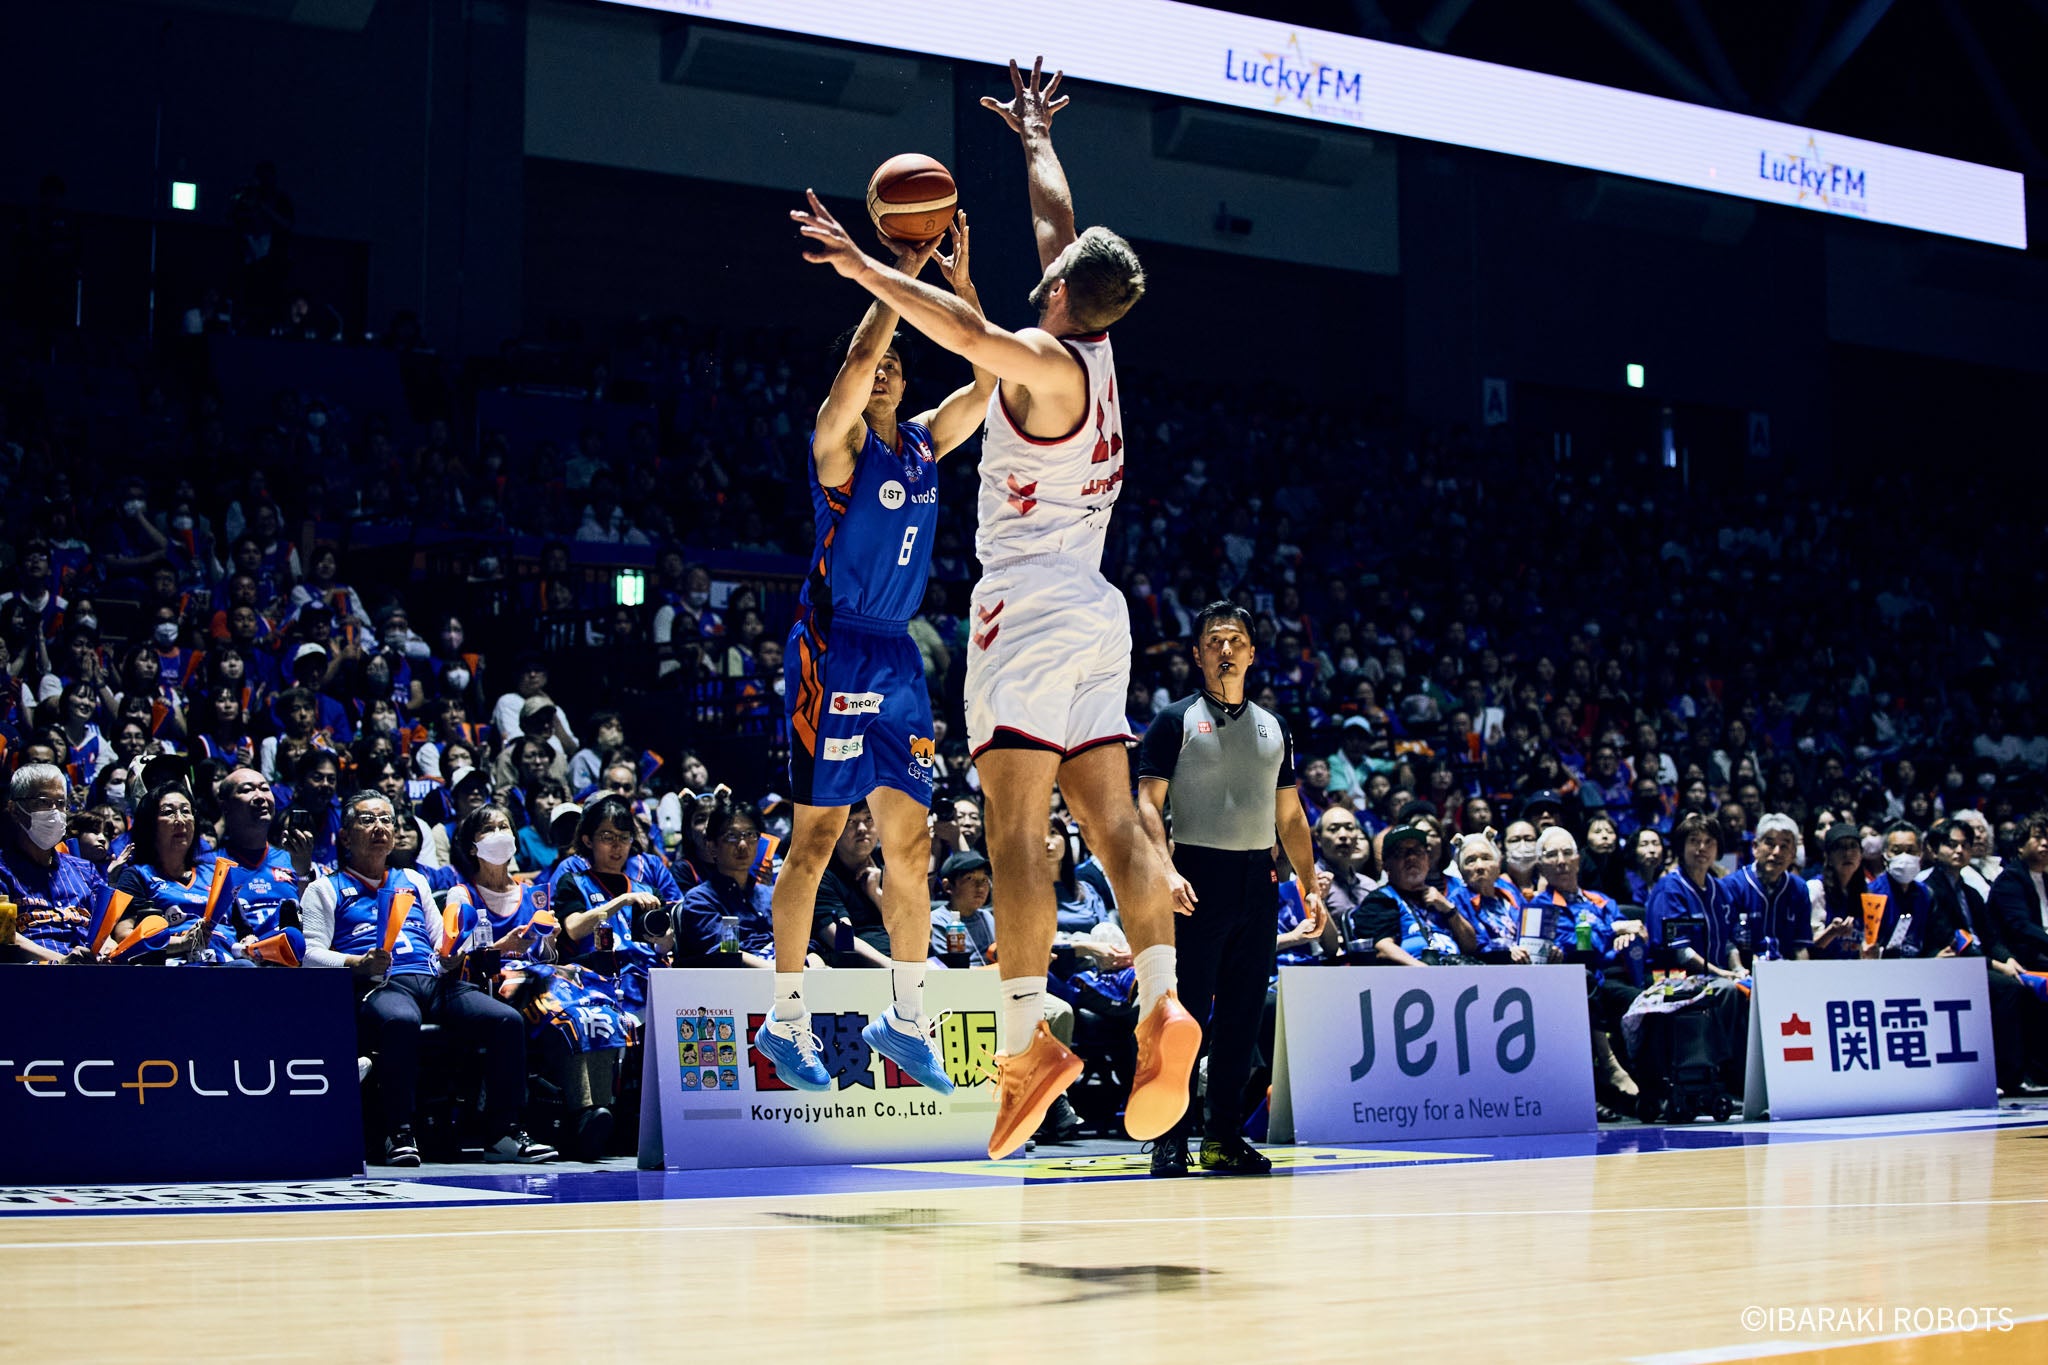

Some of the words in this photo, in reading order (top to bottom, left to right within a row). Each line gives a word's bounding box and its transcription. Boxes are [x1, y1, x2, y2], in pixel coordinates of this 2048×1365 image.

[1489, 387, 1502, 413] A
[897, 525, 919, 567] 8
[675, 1008, 697, 1016] GOOD
[706, 1008, 734, 1016] PEOPLE
[1826, 998, 1979, 1072] 関電工
[0, 1059, 329, 1105] ECPLUS
[751, 1103, 867, 1124] Koryojyuhan
[1353, 1102, 1418, 1128] Energy
[1424, 1099, 1449, 1121] for
[1454, 1105, 1465, 1120] a
[1469, 1098, 1510, 1119] New
[1515, 1096, 1543, 1117] Era
